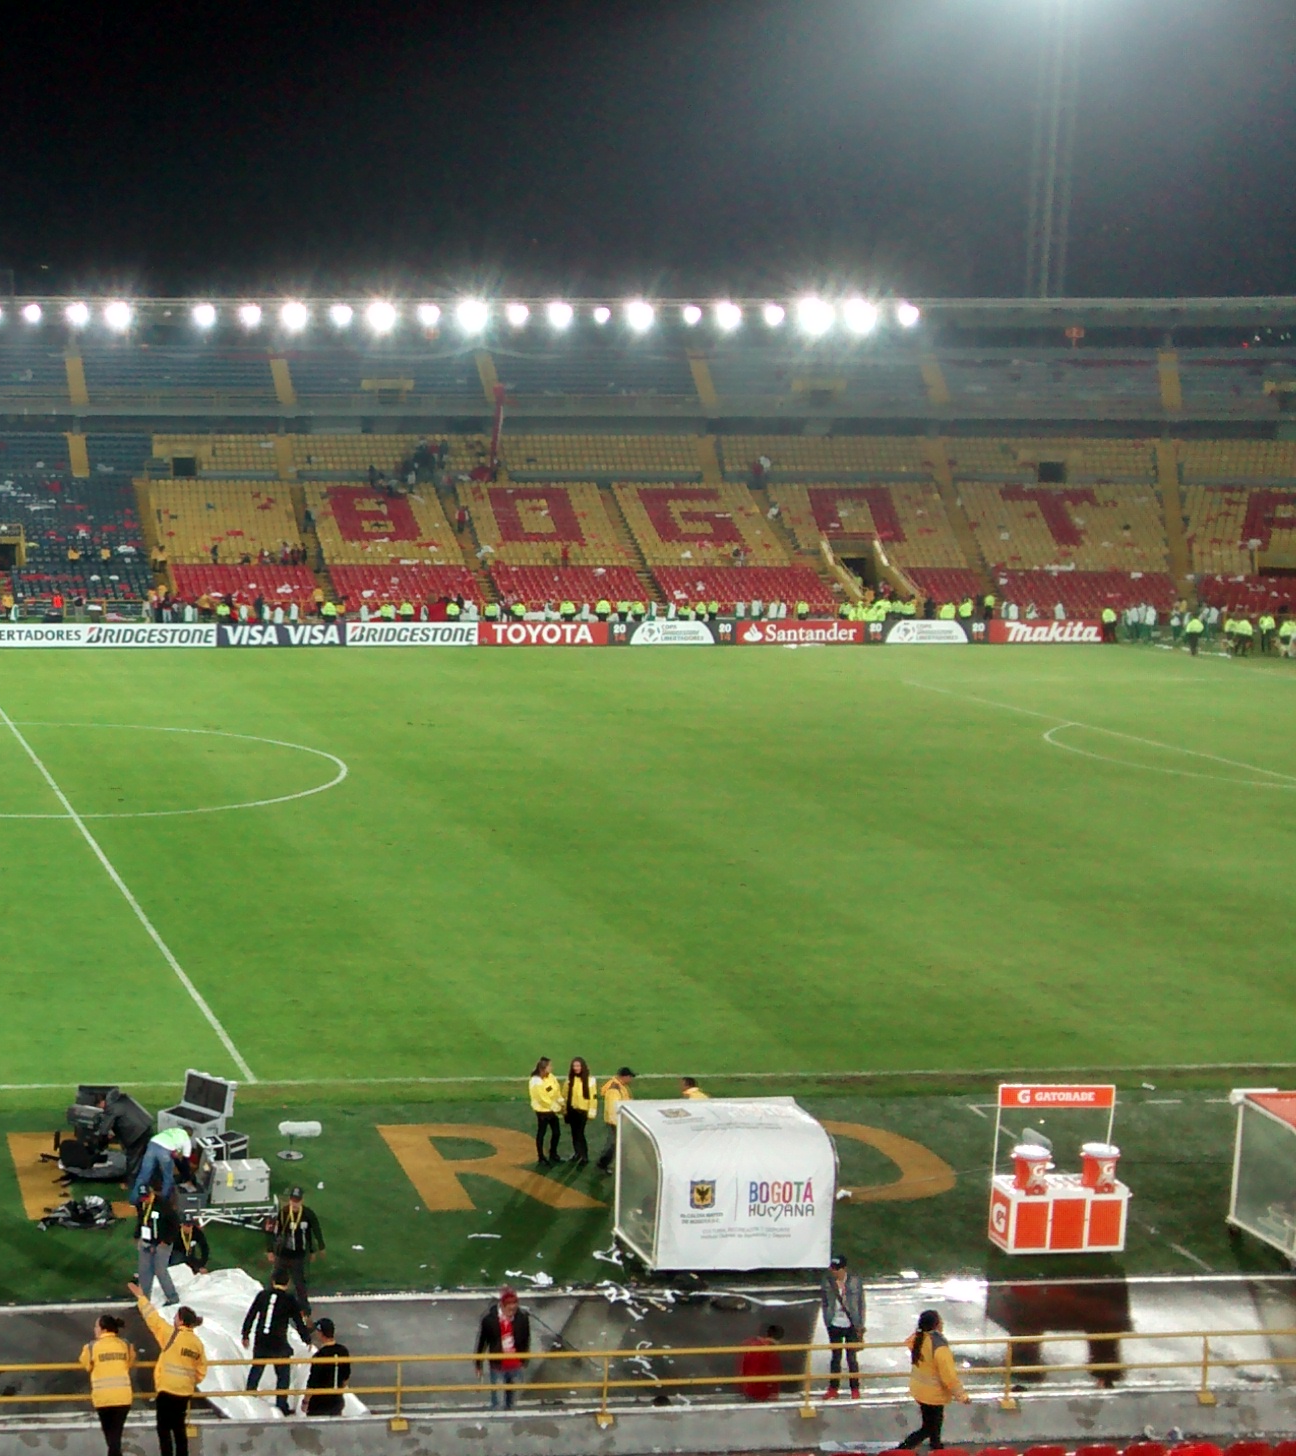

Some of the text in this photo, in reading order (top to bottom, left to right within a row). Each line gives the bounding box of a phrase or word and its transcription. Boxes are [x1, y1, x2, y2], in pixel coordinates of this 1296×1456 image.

[86, 626, 214, 645] BRIDGESTONE
[222, 625, 340, 645] VISA VISA
[348, 626, 477, 643] BRIDGESTONE
[492, 624, 593, 644] TOYOTA
[765, 623, 856, 643] Santander
[1035, 1091, 1095, 1102] GATORADE
[749, 1177, 814, 1203] BOGOTÁ
